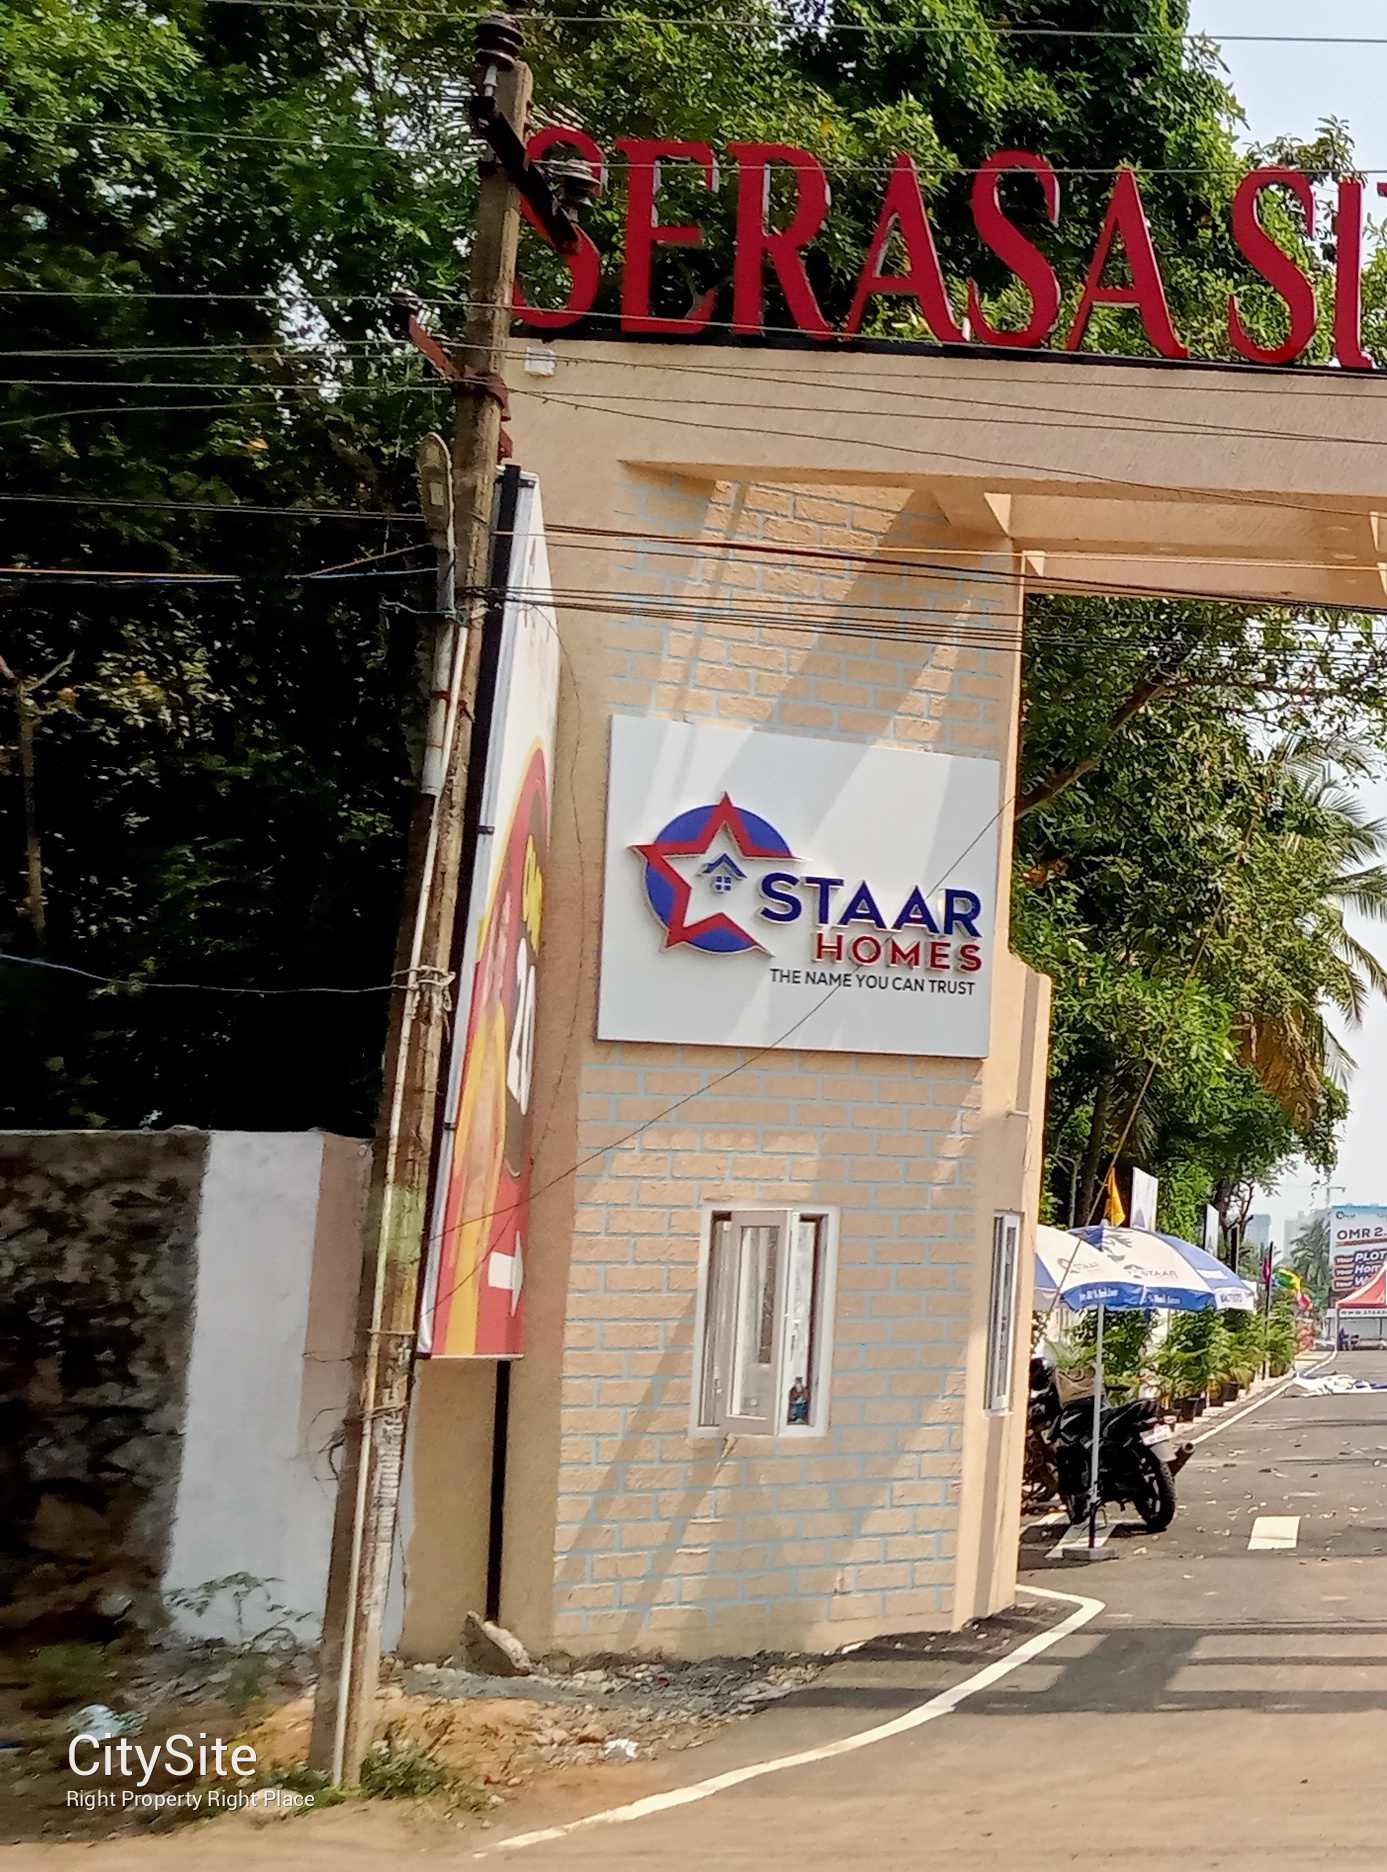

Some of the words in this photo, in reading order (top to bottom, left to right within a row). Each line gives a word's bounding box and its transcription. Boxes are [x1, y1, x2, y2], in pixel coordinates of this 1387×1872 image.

[513, 124, 1188, 359] SERASA
[760, 871, 983, 938] STAAR
[815, 932, 983, 972] HOMES
[769, 967, 802, 985] THE
[804, 970, 853, 988] NAME
[856, 973, 890, 990] YOU
[891, 976, 925, 992] CAN
[928, 979, 976, 996] TRUST
[1336, 1228, 1371, 1240] OMR
[1354, 1250, 1387, 1262] PLOT
[1354, 1264, 1382, 1275] Hom
